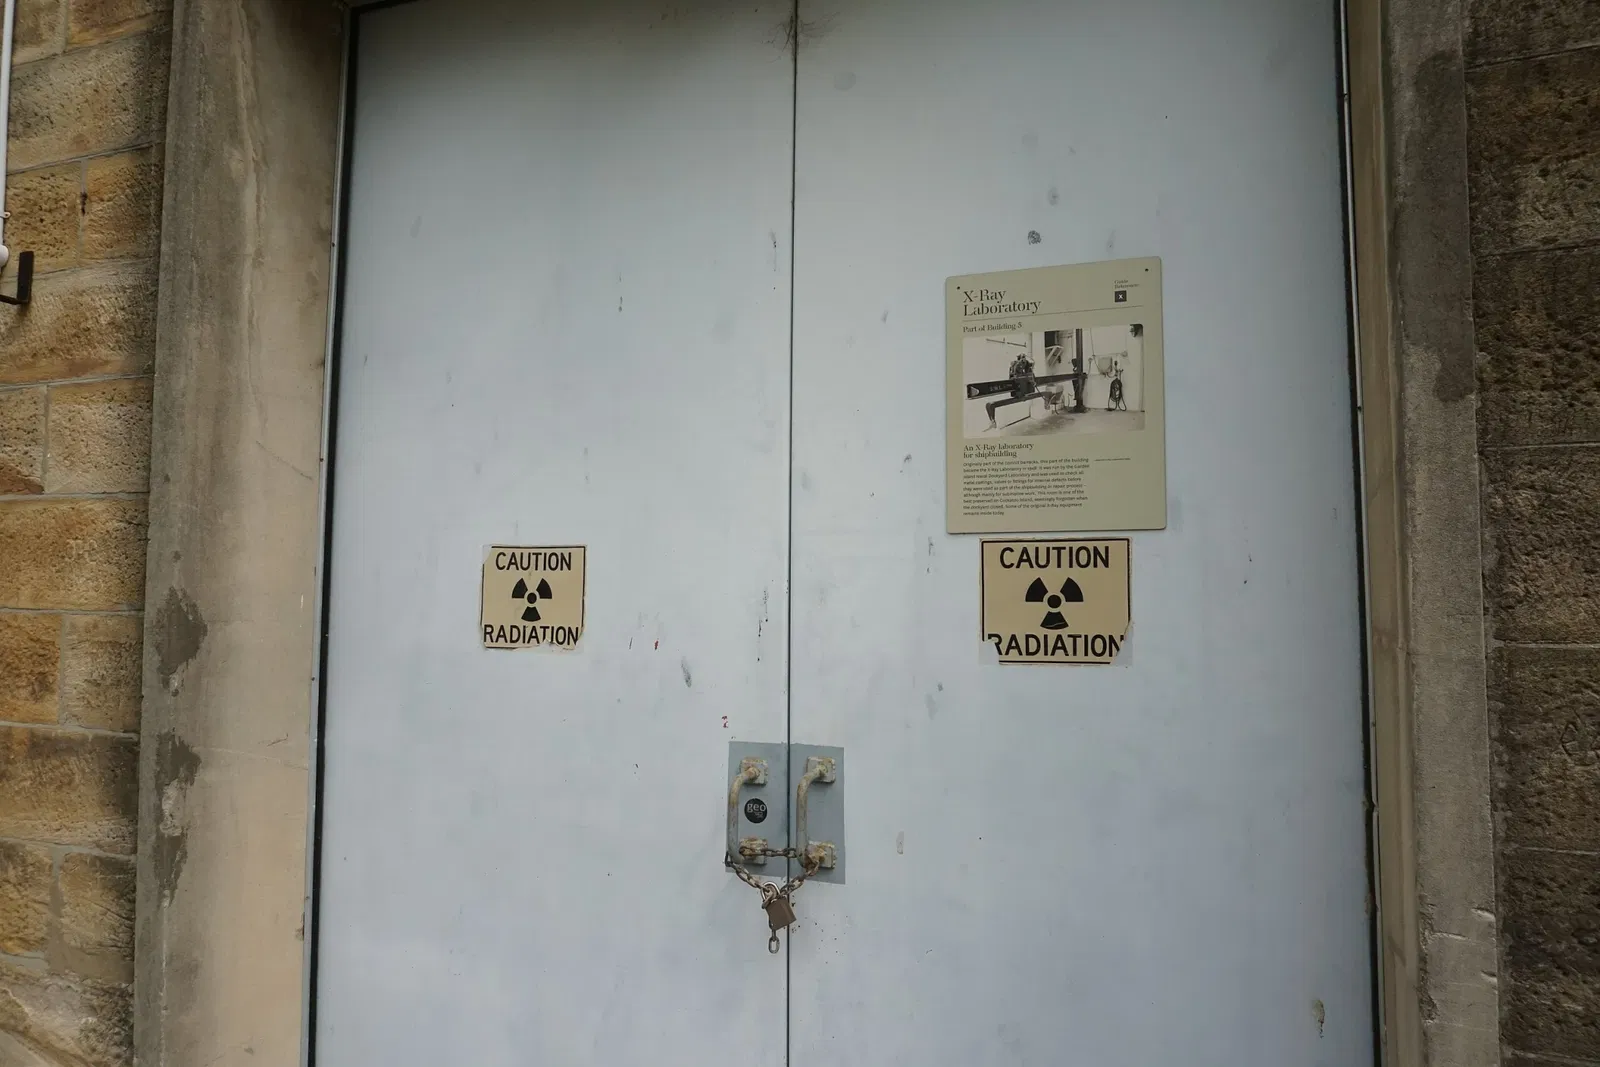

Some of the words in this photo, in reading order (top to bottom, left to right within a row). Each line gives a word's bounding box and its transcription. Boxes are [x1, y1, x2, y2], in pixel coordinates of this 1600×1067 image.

[963, 289, 1006, 304] X-Ray
[964, 300, 1042, 316] Laboratory
[987, 322, 1016, 331] Building
[1018, 321, 1023, 329] 5
[975, 444, 996, 452] X-Ray
[998, 443, 1034, 452] laboratory
[975, 450, 1018, 460] shipbuilding
[495, 552, 572, 571] CAUTION
[1000, 546, 1110, 569] CAUTION
[484, 624, 579, 646] RADIATION
[988, 633, 1124, 658] RADIATION
[747, 803, 766, 813] geo
